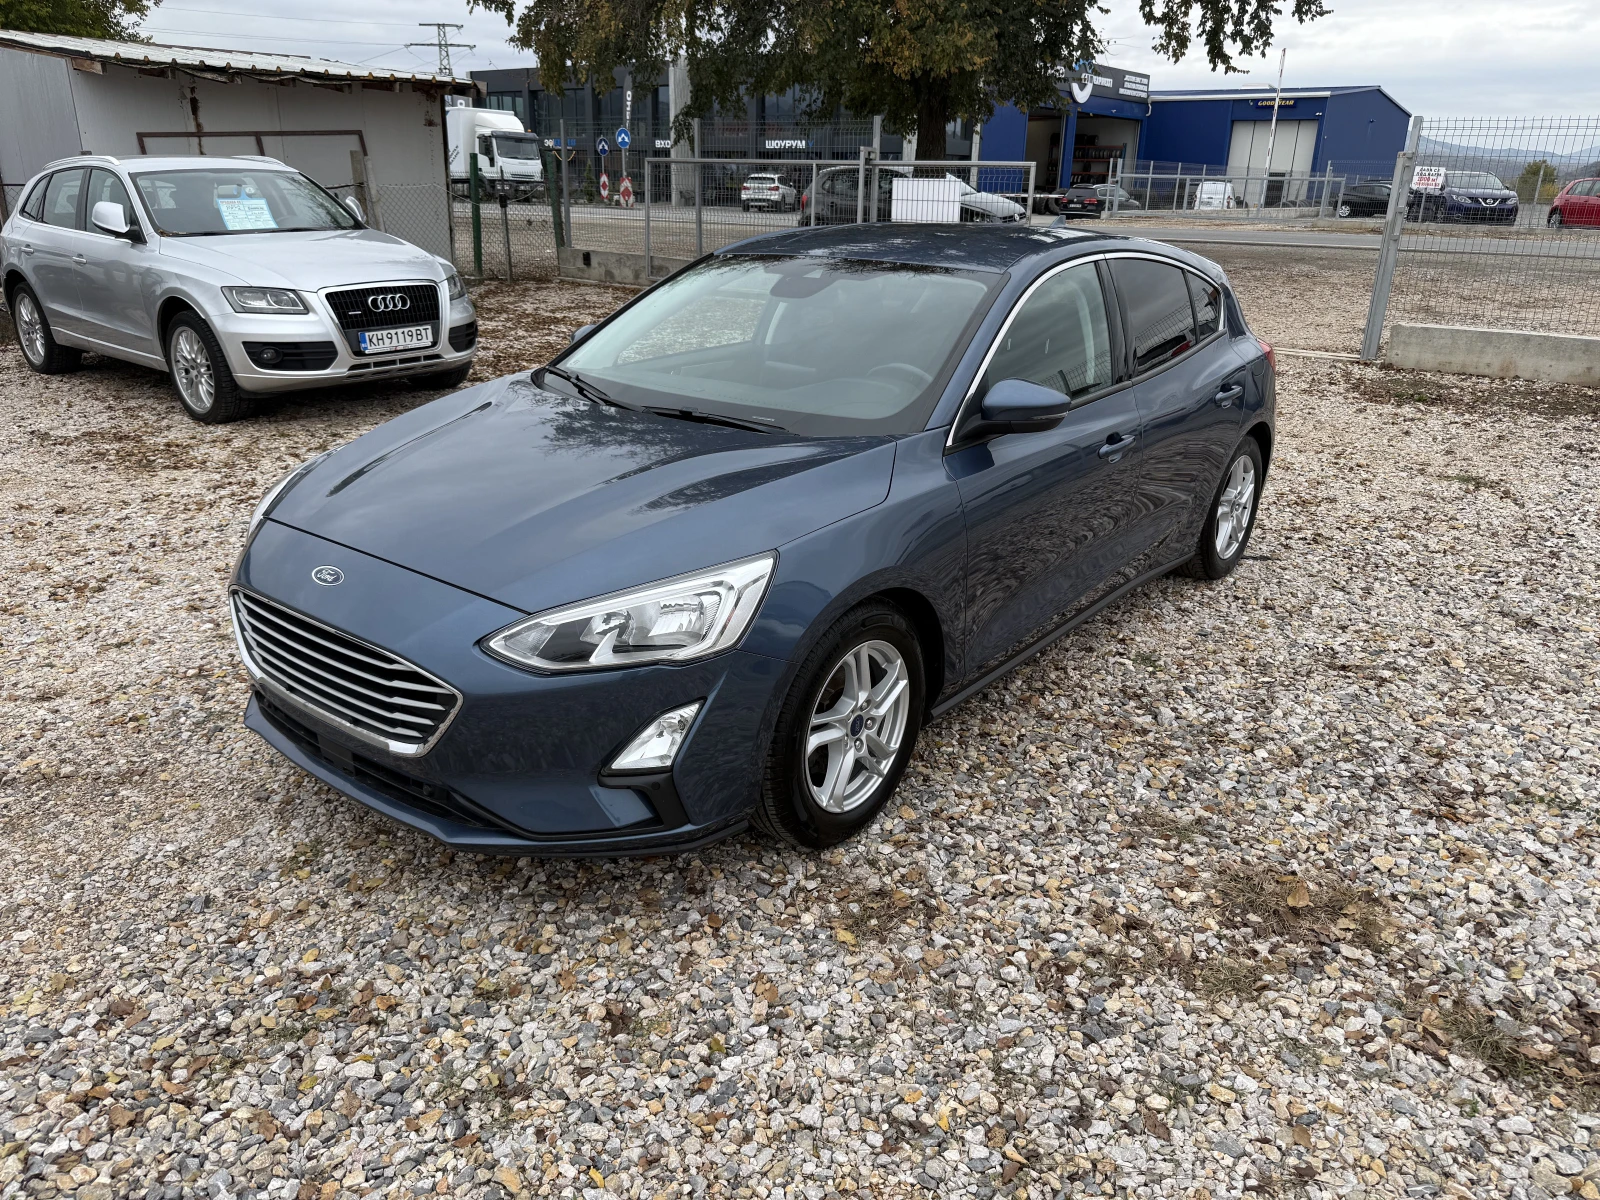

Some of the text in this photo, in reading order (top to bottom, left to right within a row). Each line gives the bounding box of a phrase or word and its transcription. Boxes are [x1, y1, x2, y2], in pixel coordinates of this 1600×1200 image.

[655, 139, 671, 148] ВХО
[765, 140, 806, 149] ШОУРУМ
[367, 327, 430, 348] KH9119BT
